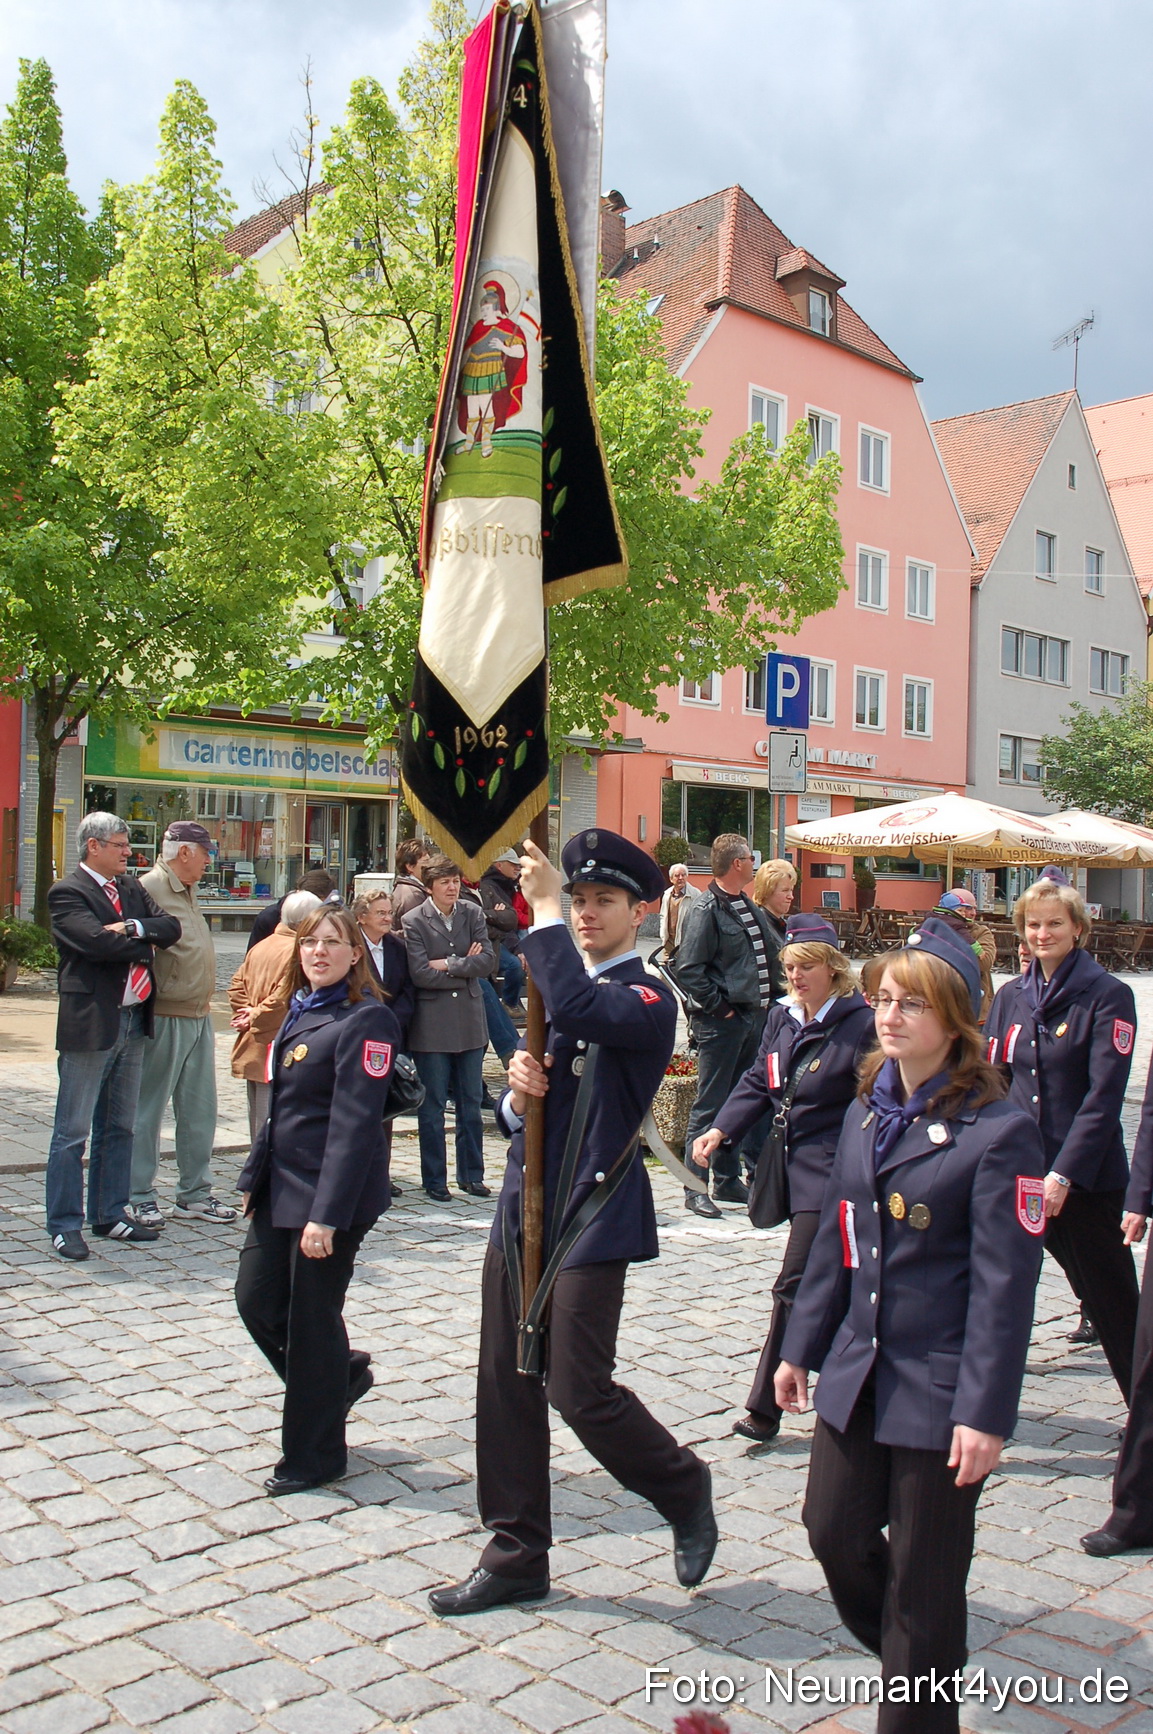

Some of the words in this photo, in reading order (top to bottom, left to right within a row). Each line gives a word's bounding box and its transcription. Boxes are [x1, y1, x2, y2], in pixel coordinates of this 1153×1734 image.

[776, 663, 801, 717] P
[454, 724, 509, 755] 1962
[827, 749, 879, 769] MARKT
[812, 781, 825, 791] AM
[826, 782, 852, 793] MARKT
[803, 832, 886, 846] Franziskaner
[891, 831, 958, 846] Weissbier
[1020, 834, 1072, 852] Franziskaner
